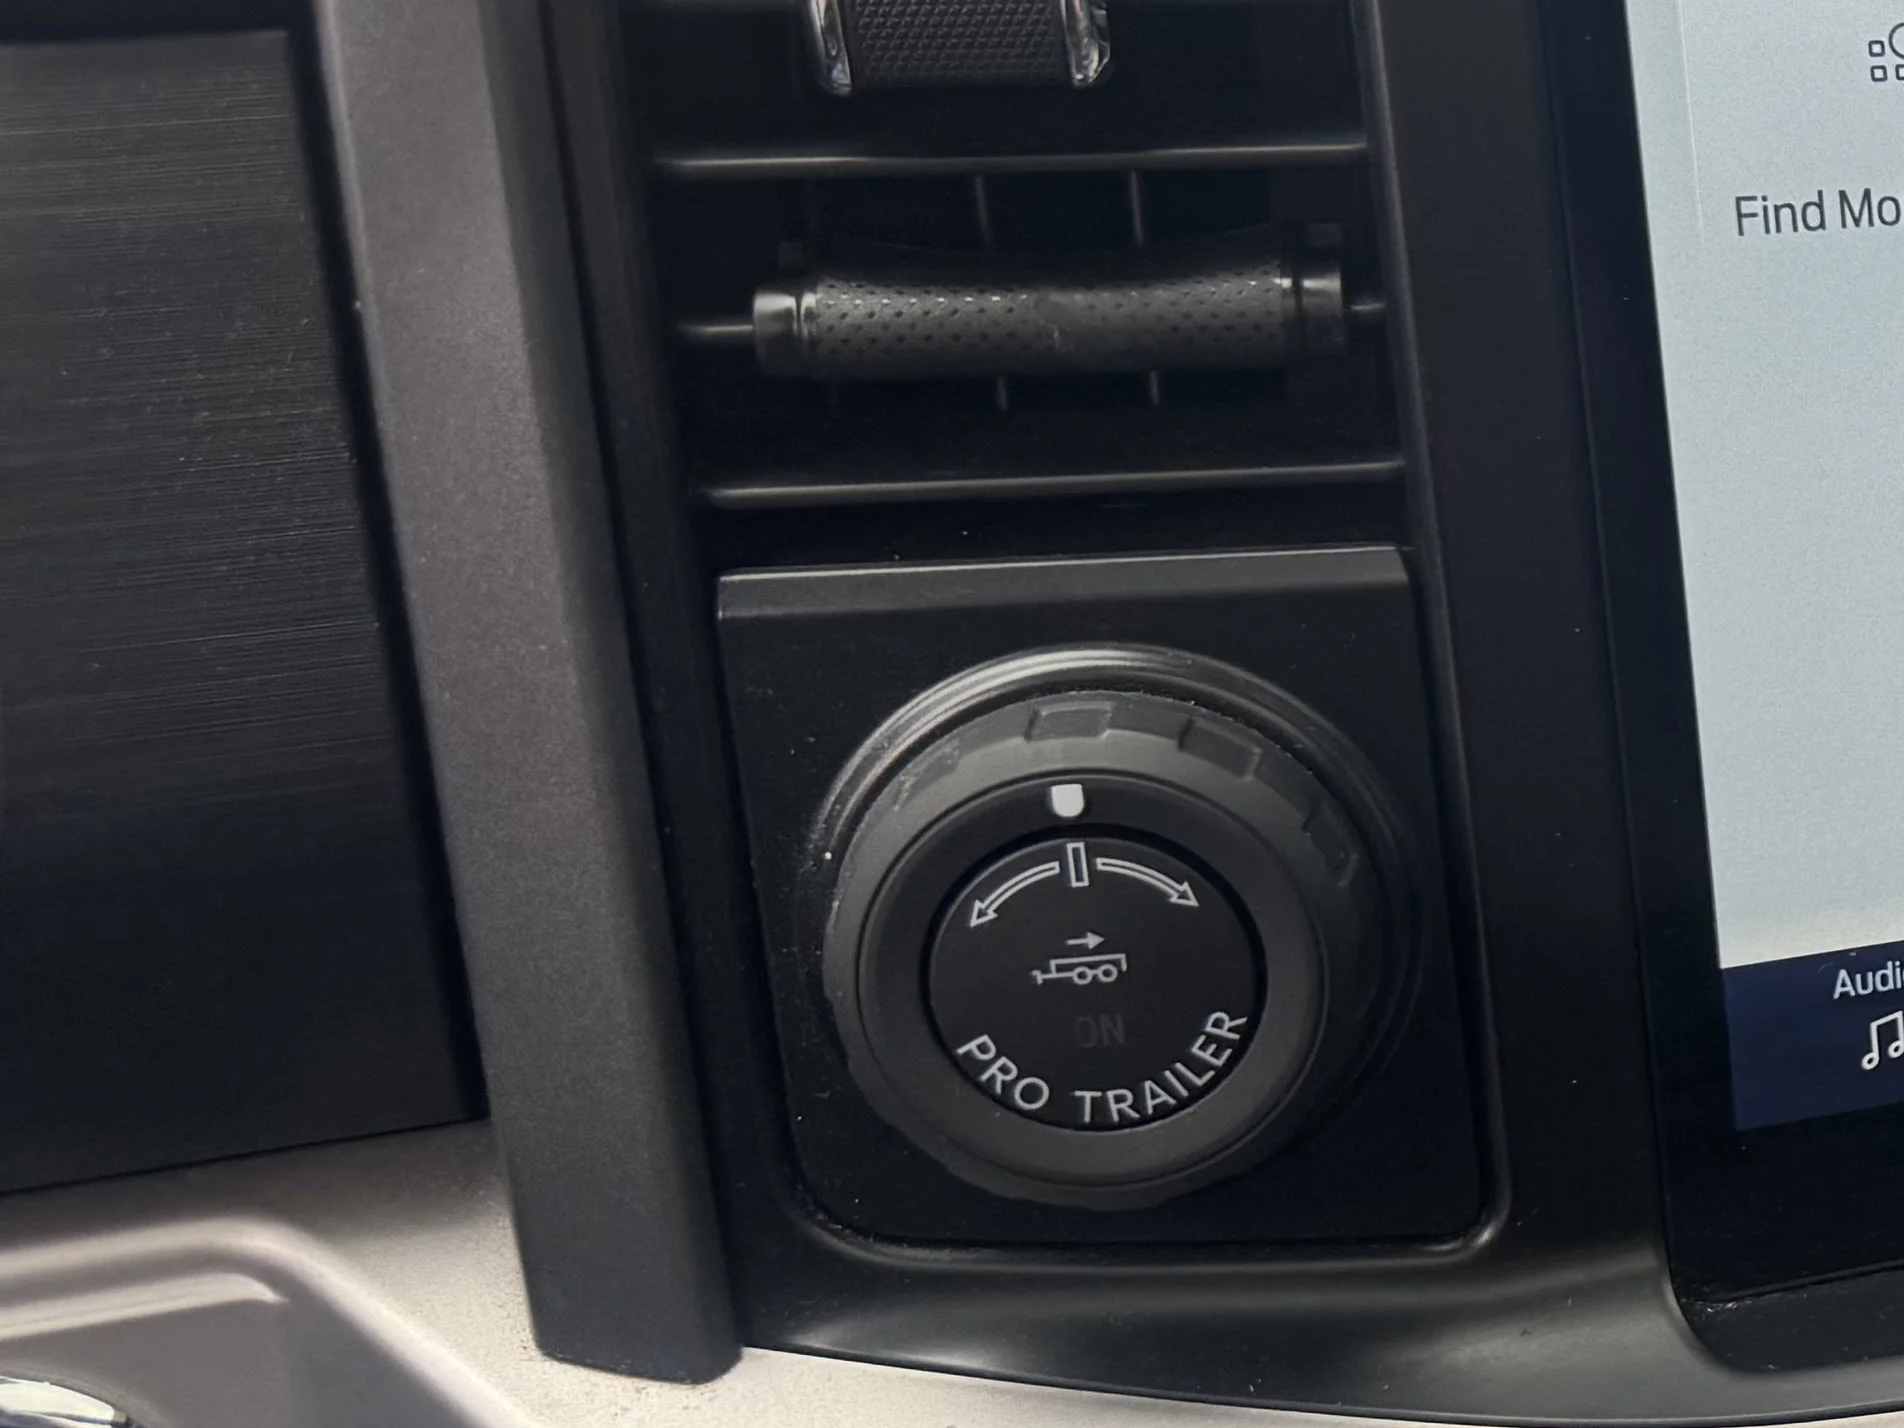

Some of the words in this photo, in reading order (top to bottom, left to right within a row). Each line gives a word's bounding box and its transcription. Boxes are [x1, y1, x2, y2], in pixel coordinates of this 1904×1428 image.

[1735, 189, 1827, 238] Find
[955, 1034, 1050, 1111] PRO
[1071, 1011, 1248, 1124] TRAILER
